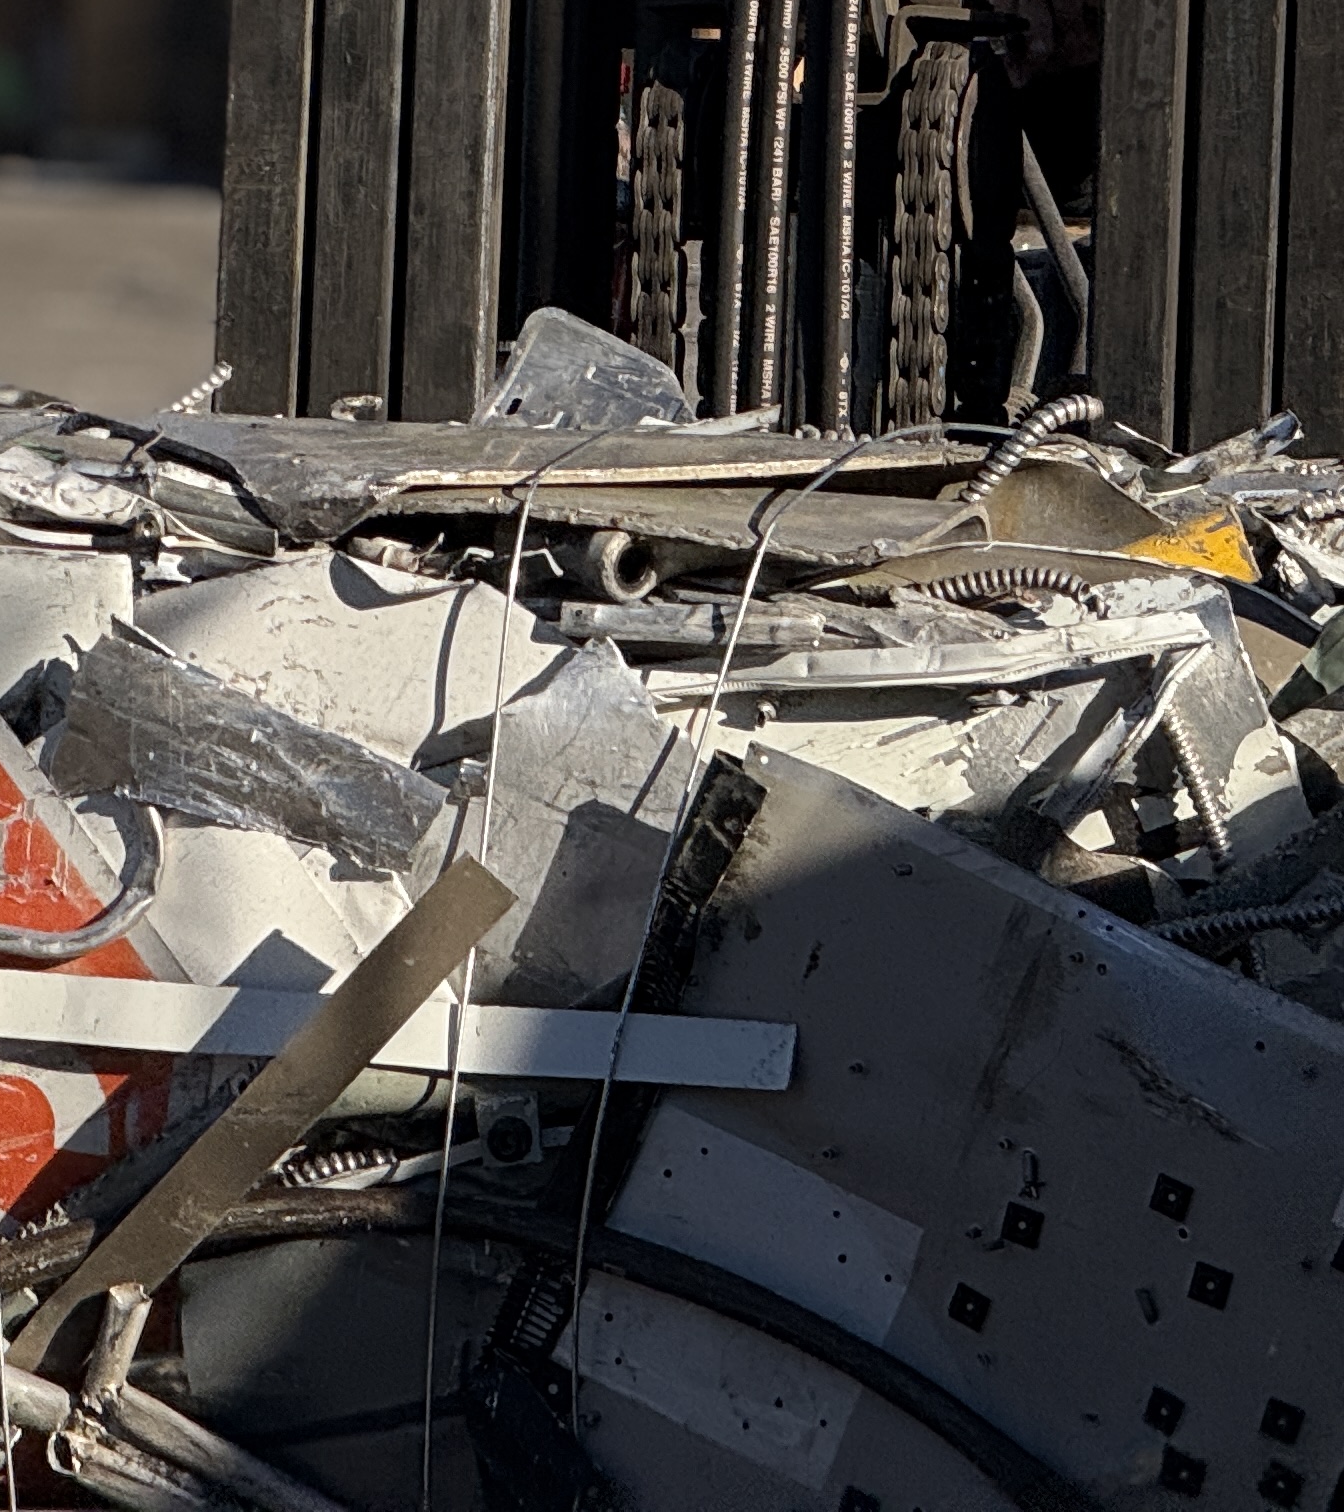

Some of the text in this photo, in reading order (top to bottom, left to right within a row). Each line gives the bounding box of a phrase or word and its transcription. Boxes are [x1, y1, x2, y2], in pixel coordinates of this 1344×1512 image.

[782, 0, 794, 29] mm)
[744, 51, 754, 61] 2
[846, 23, 857, 57] BAR)
[778, 47, 790, 79] 3500
[742, 64, 753, 99] WIRE
[776, 81, 788, 104] PSI
[740, 107, 749, 147] MSHA
[775, 108, 786, 131] WP
[844, 72, 855, 150] SAE100R16
[772, 136, 784, 163] (241
[844, 159, 852, 169] 2
[771, 168, 782, 202] BAR)
[842, 172, 851, 208] WIRE
[842, 215, 852, 255] MSHA
[766, 216, 781, 293] SAE100R16
[840, 259, 851, 319] IC-101/34
[765, 304, 776, 312] 2
[763, 316, 776, 352] WIRE
[761, 359, 774, 398] MSHA
[838, 391, 848, 417] 8TX
